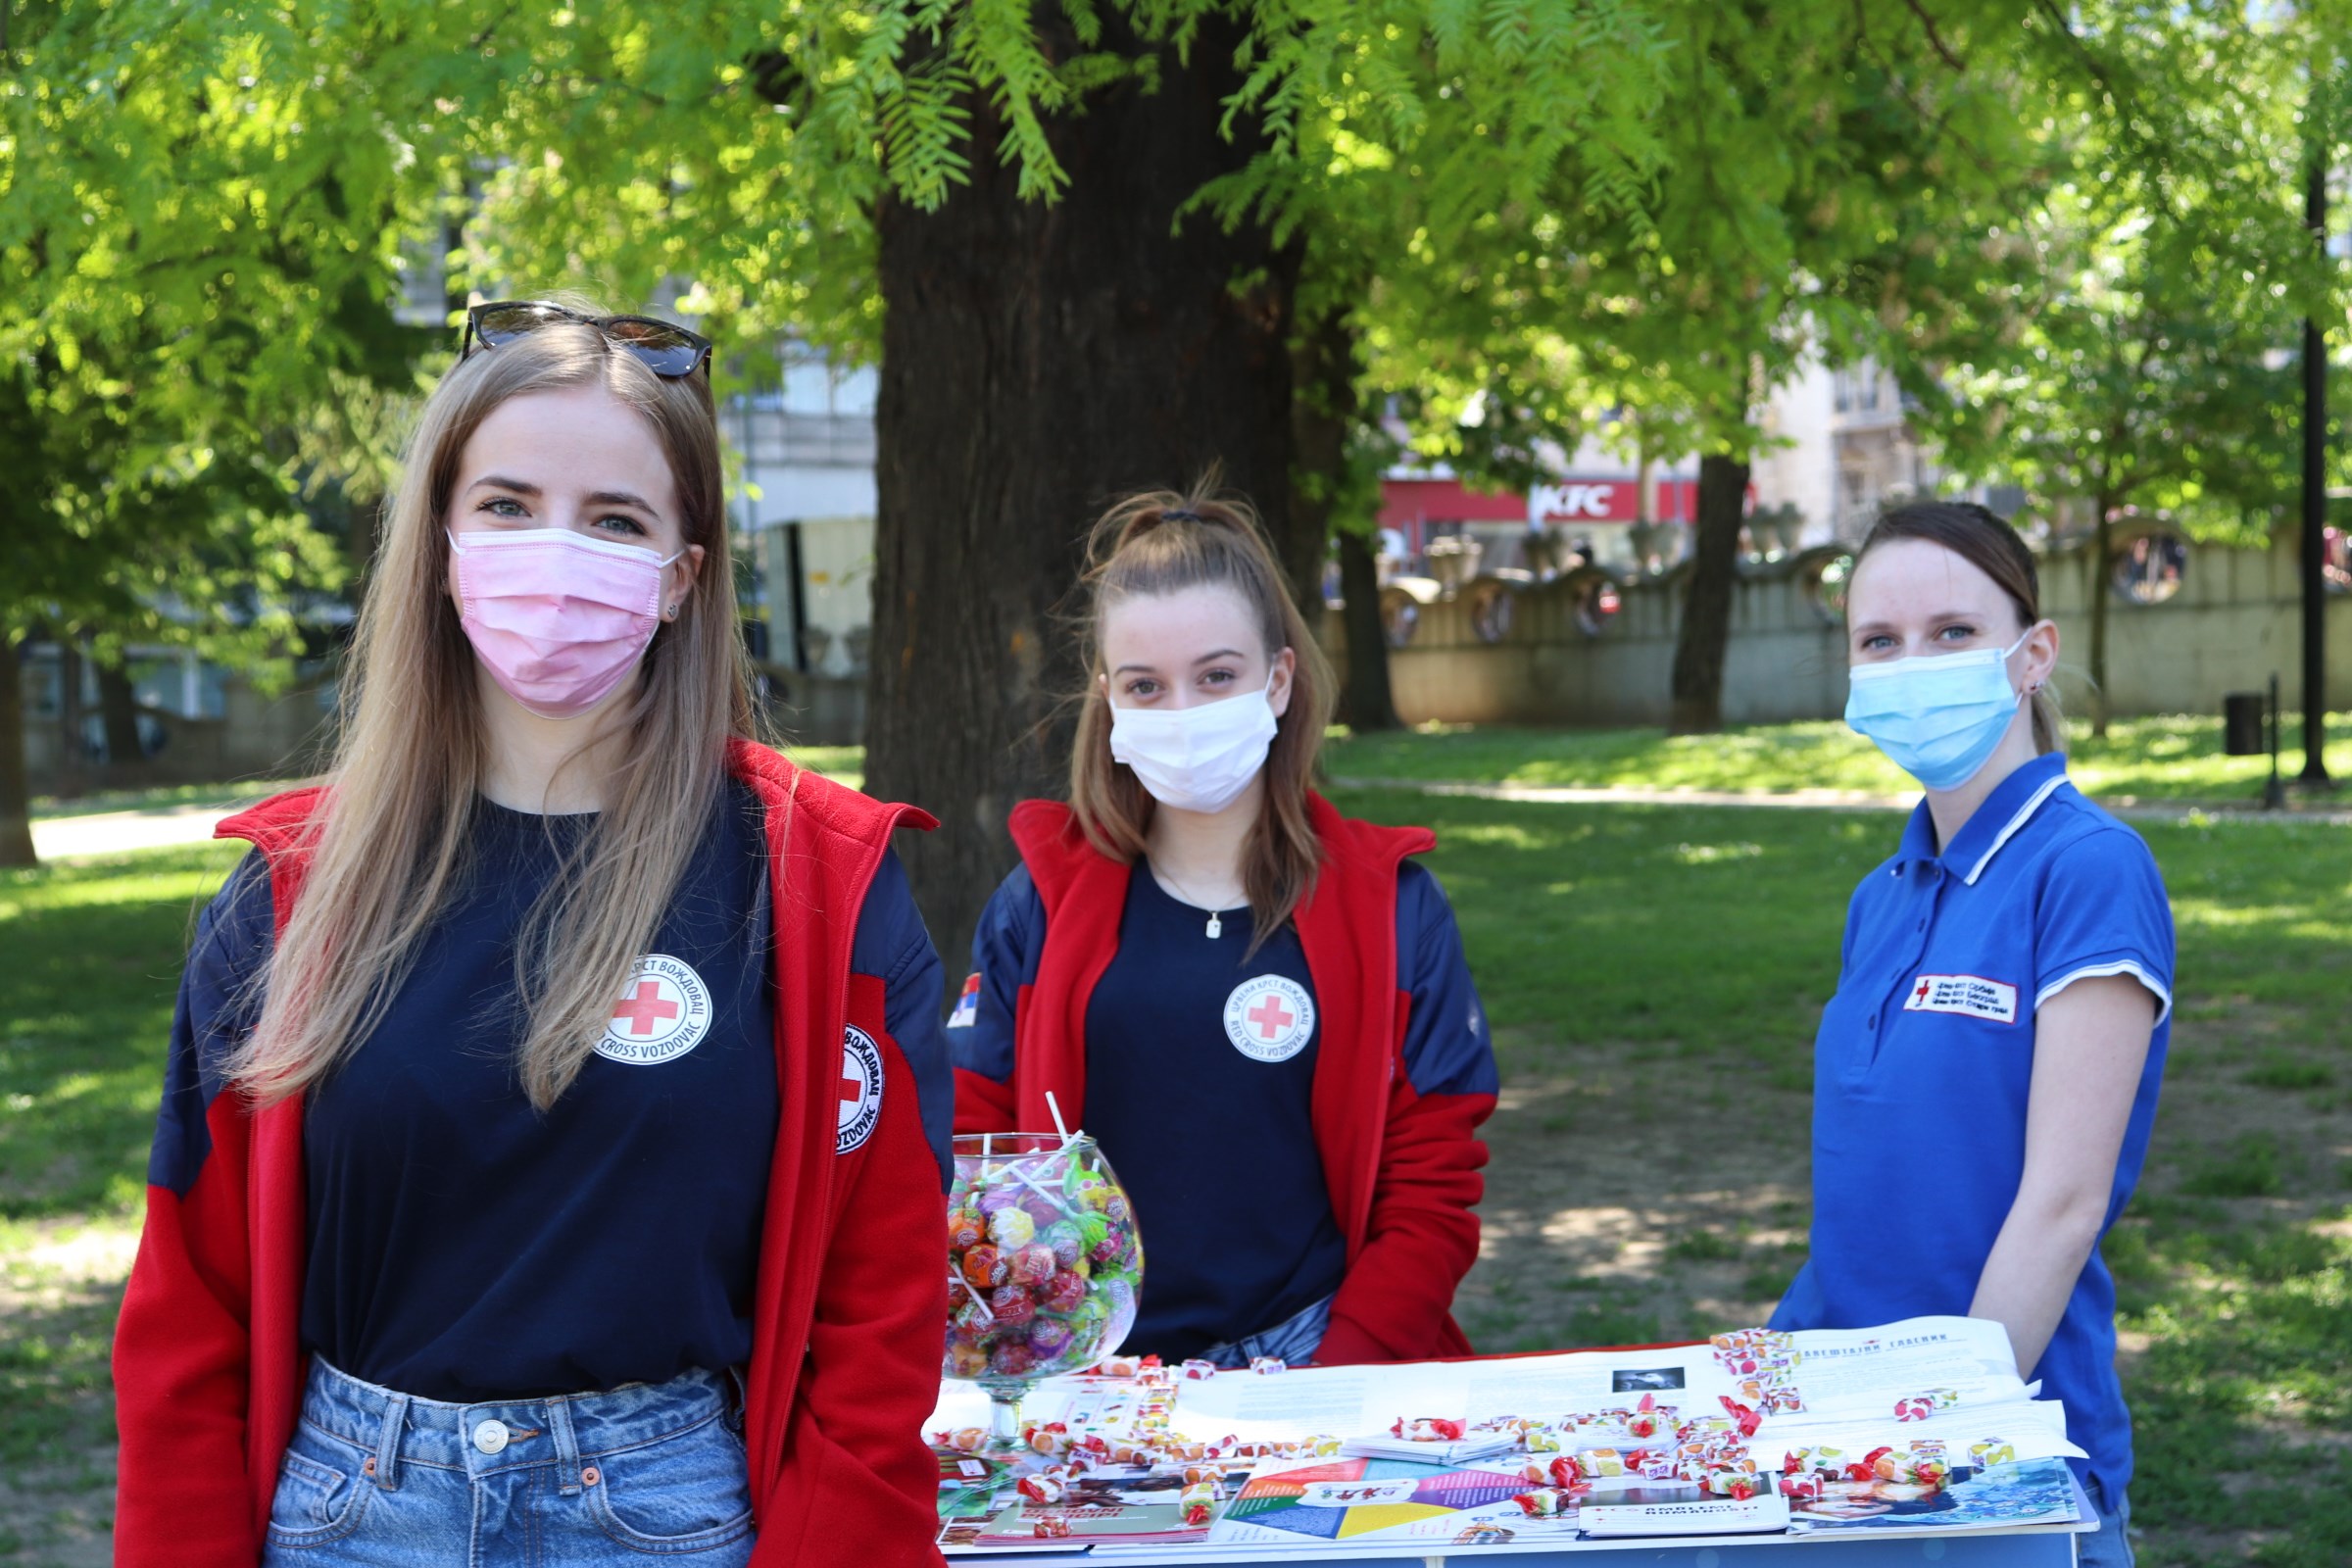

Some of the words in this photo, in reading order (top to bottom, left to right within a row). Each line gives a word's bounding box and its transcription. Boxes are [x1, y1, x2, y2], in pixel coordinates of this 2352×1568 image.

[1532, 484, 1614, 517] KFC
[631, 959, 658, 974] РСТ
[659, 961, 705, 1015] ВОЖДОВАЦ
[600, 1037, 639, 1058] CROSS
[640, 1020, 702, 1058] VOZDOVAC
[1230, 1020, 1244, 1039] RED
[1239, 1037, 1265, 1056] CROSS
[1266, 1030, 1306, 1057] VOZDOVAC
